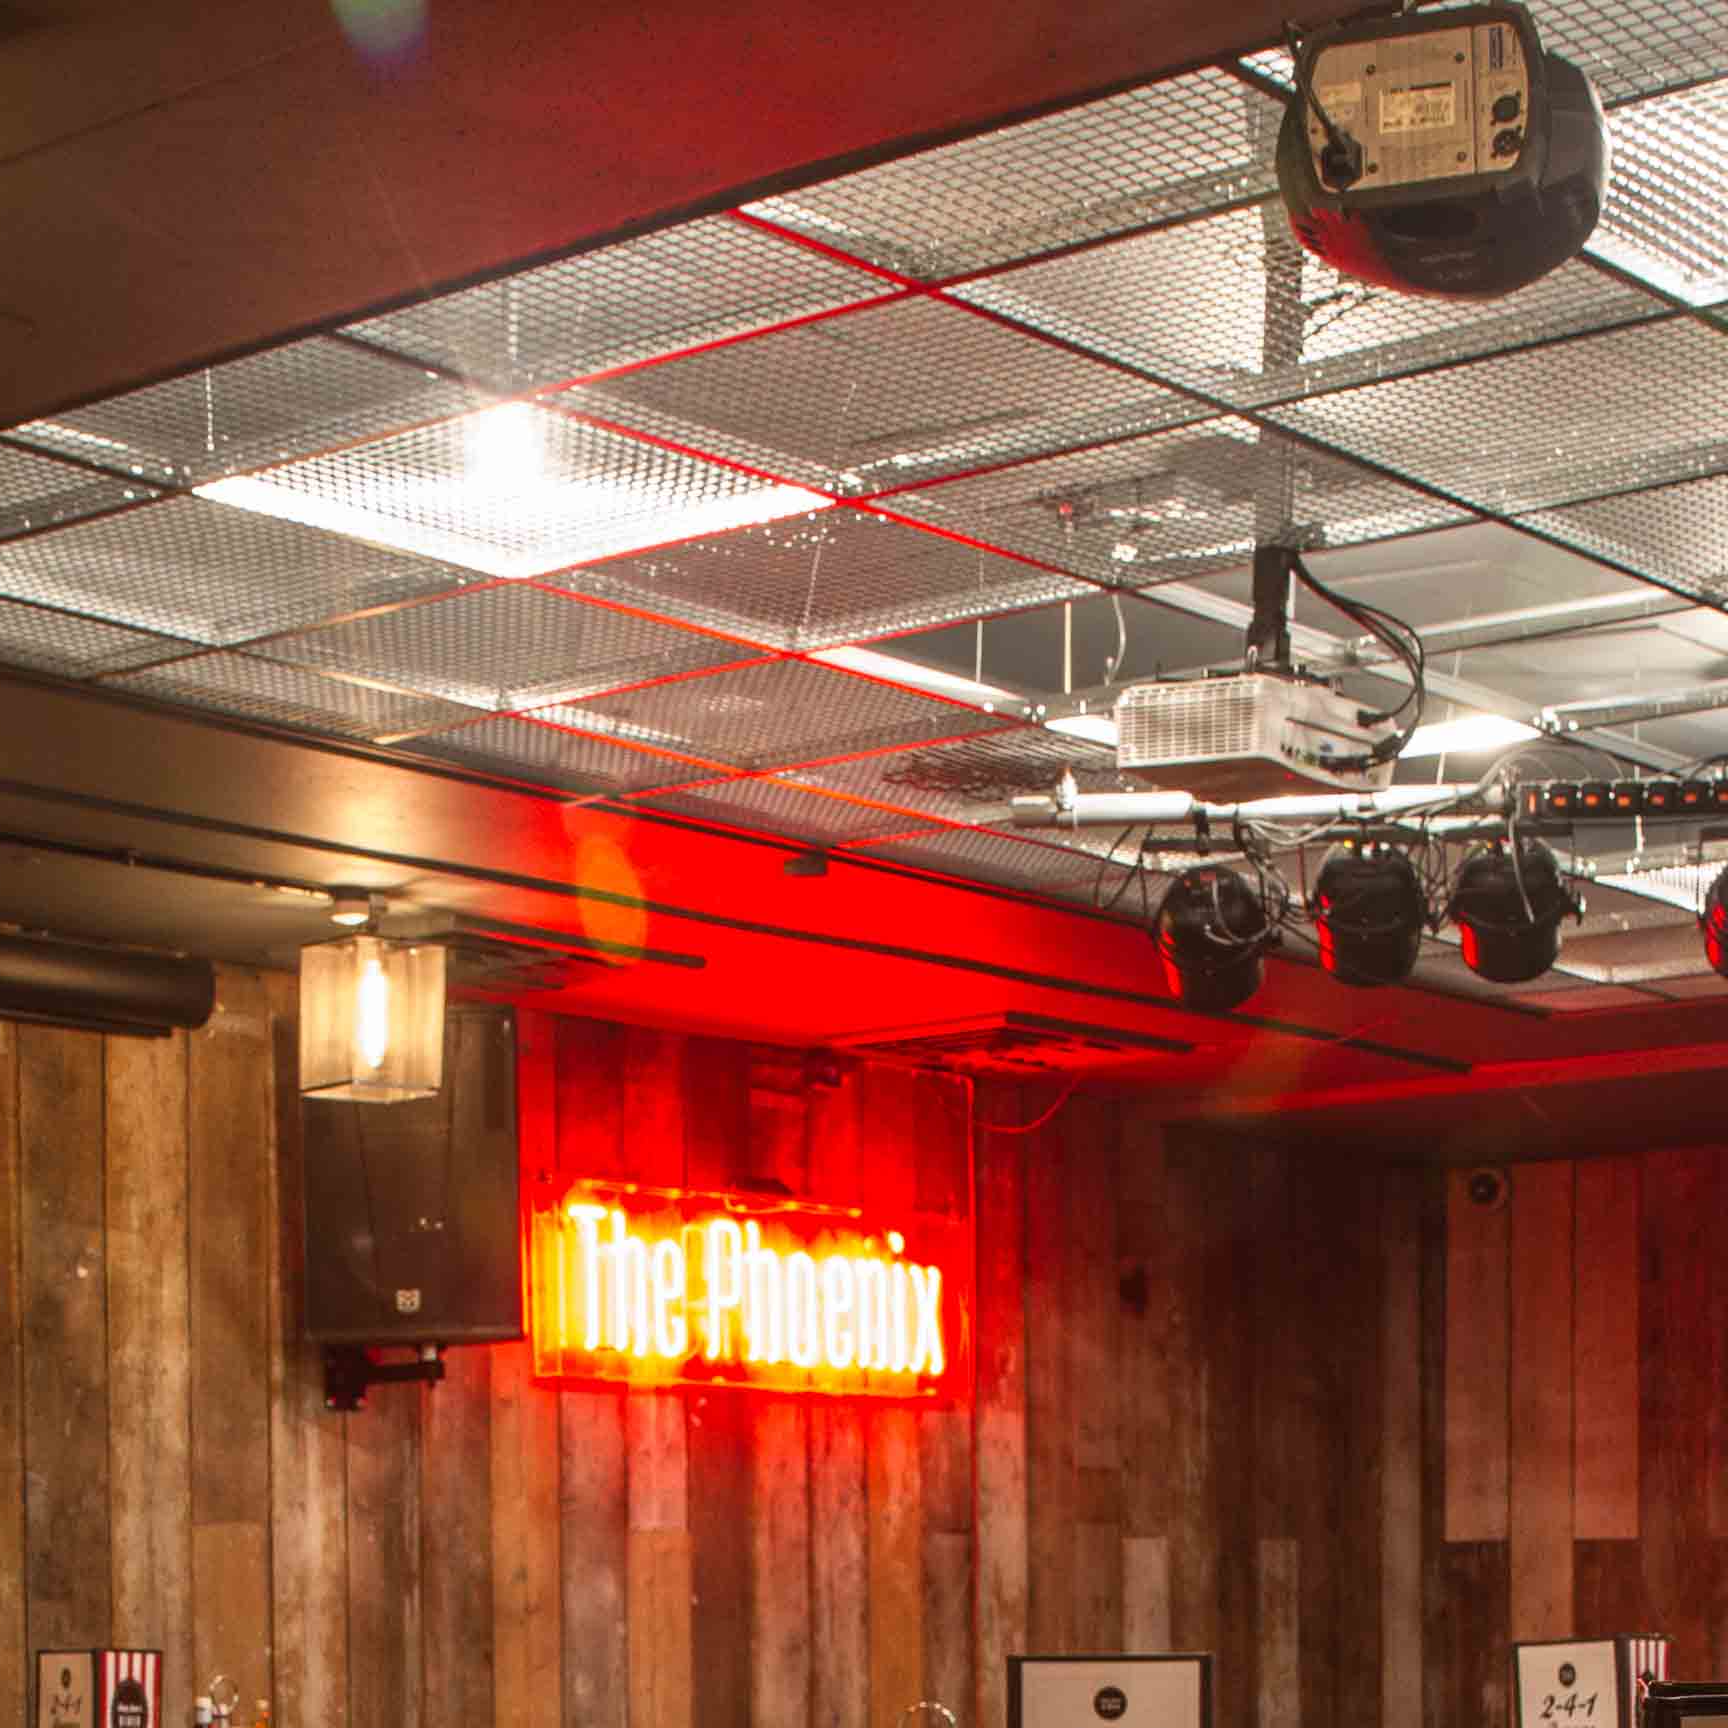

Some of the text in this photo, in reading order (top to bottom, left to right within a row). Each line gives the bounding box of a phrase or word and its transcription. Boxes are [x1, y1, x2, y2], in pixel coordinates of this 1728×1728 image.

[567, 1205, 944, 1376] The Phoenix
[1540, 1693, 1598, 1718] 2-4-1
